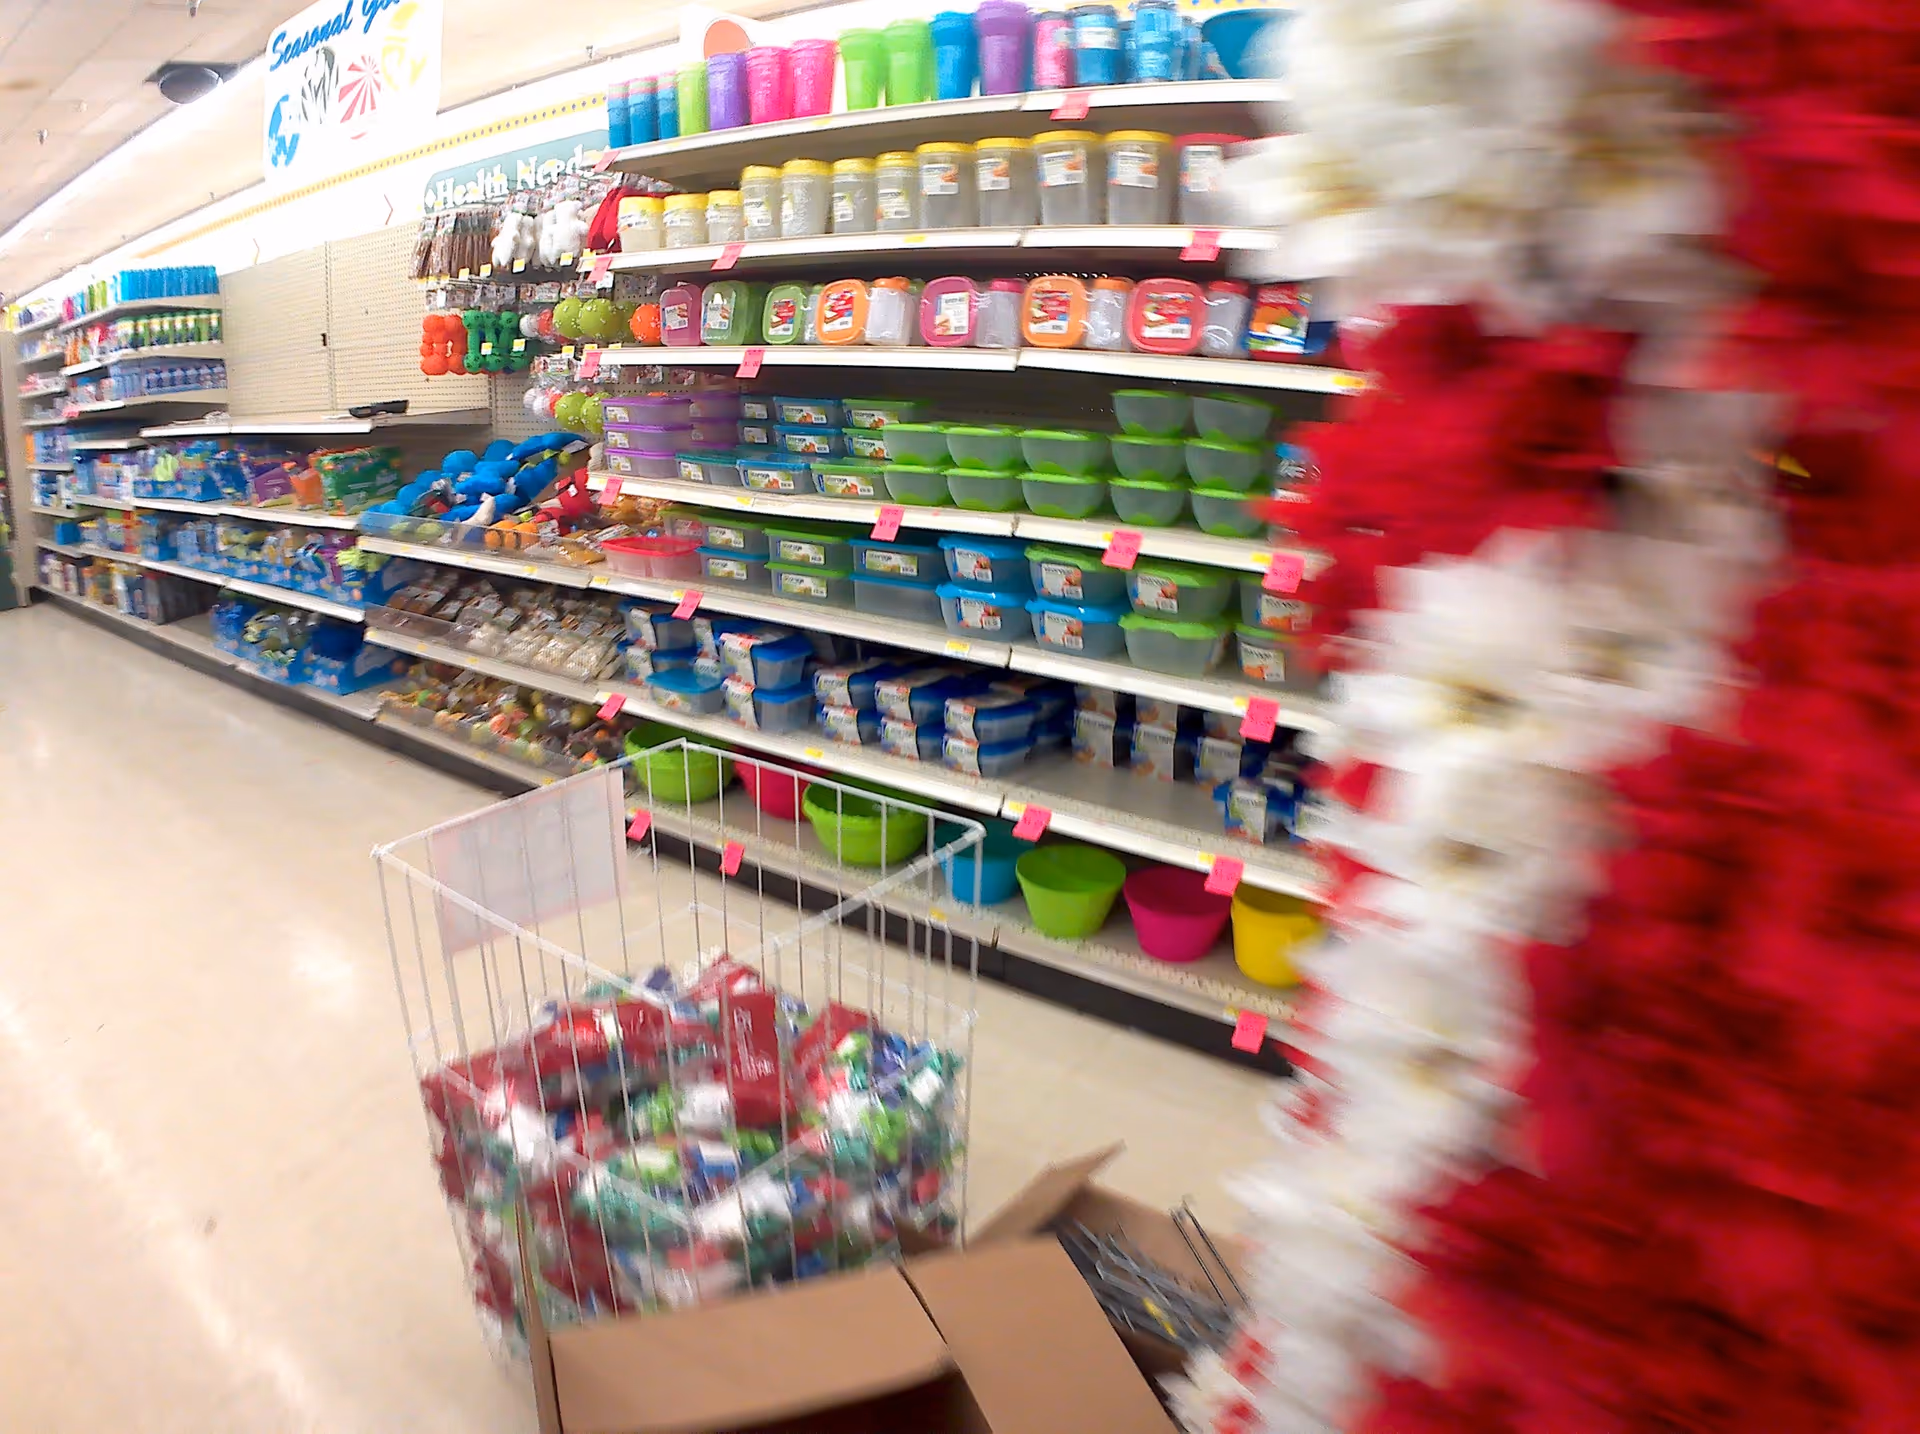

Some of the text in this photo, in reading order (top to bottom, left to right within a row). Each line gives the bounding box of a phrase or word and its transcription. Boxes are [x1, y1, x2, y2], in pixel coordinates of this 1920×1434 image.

[269, 0, 353, 72] Seasonal
[434, 143, 590, 210] Health Need
